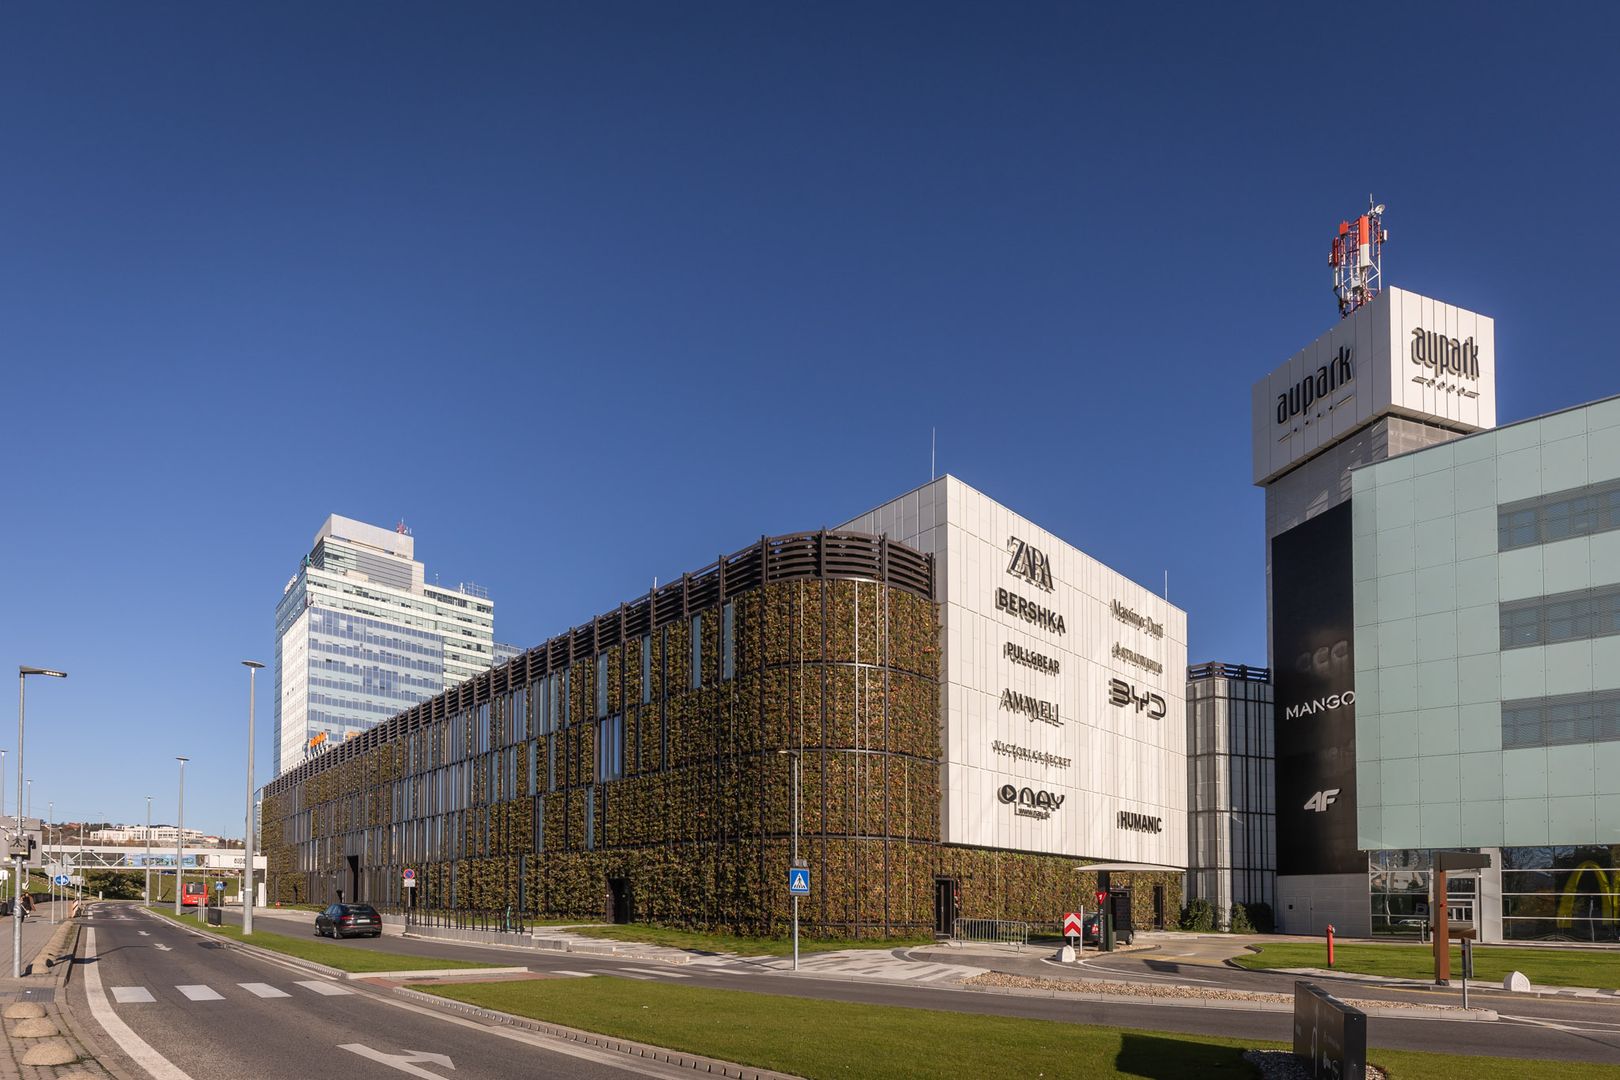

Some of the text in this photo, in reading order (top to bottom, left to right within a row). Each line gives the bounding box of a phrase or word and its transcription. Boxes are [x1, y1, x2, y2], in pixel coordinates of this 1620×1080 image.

[1414, 327, 1480, 379] aupark
[1277, 345, 1353, 425] aupark
[1010, 535, 1055, 591] ZARA
[998, 587, 1066, 634] BERSHKA
[1007, 641, 1060, 674] PULL&BEAR
[1286, 691, 1355, 720] MANGO
[1304, 788, 1340, 812] 4F
[1120, 810, 1162, 833] HUMANIC
